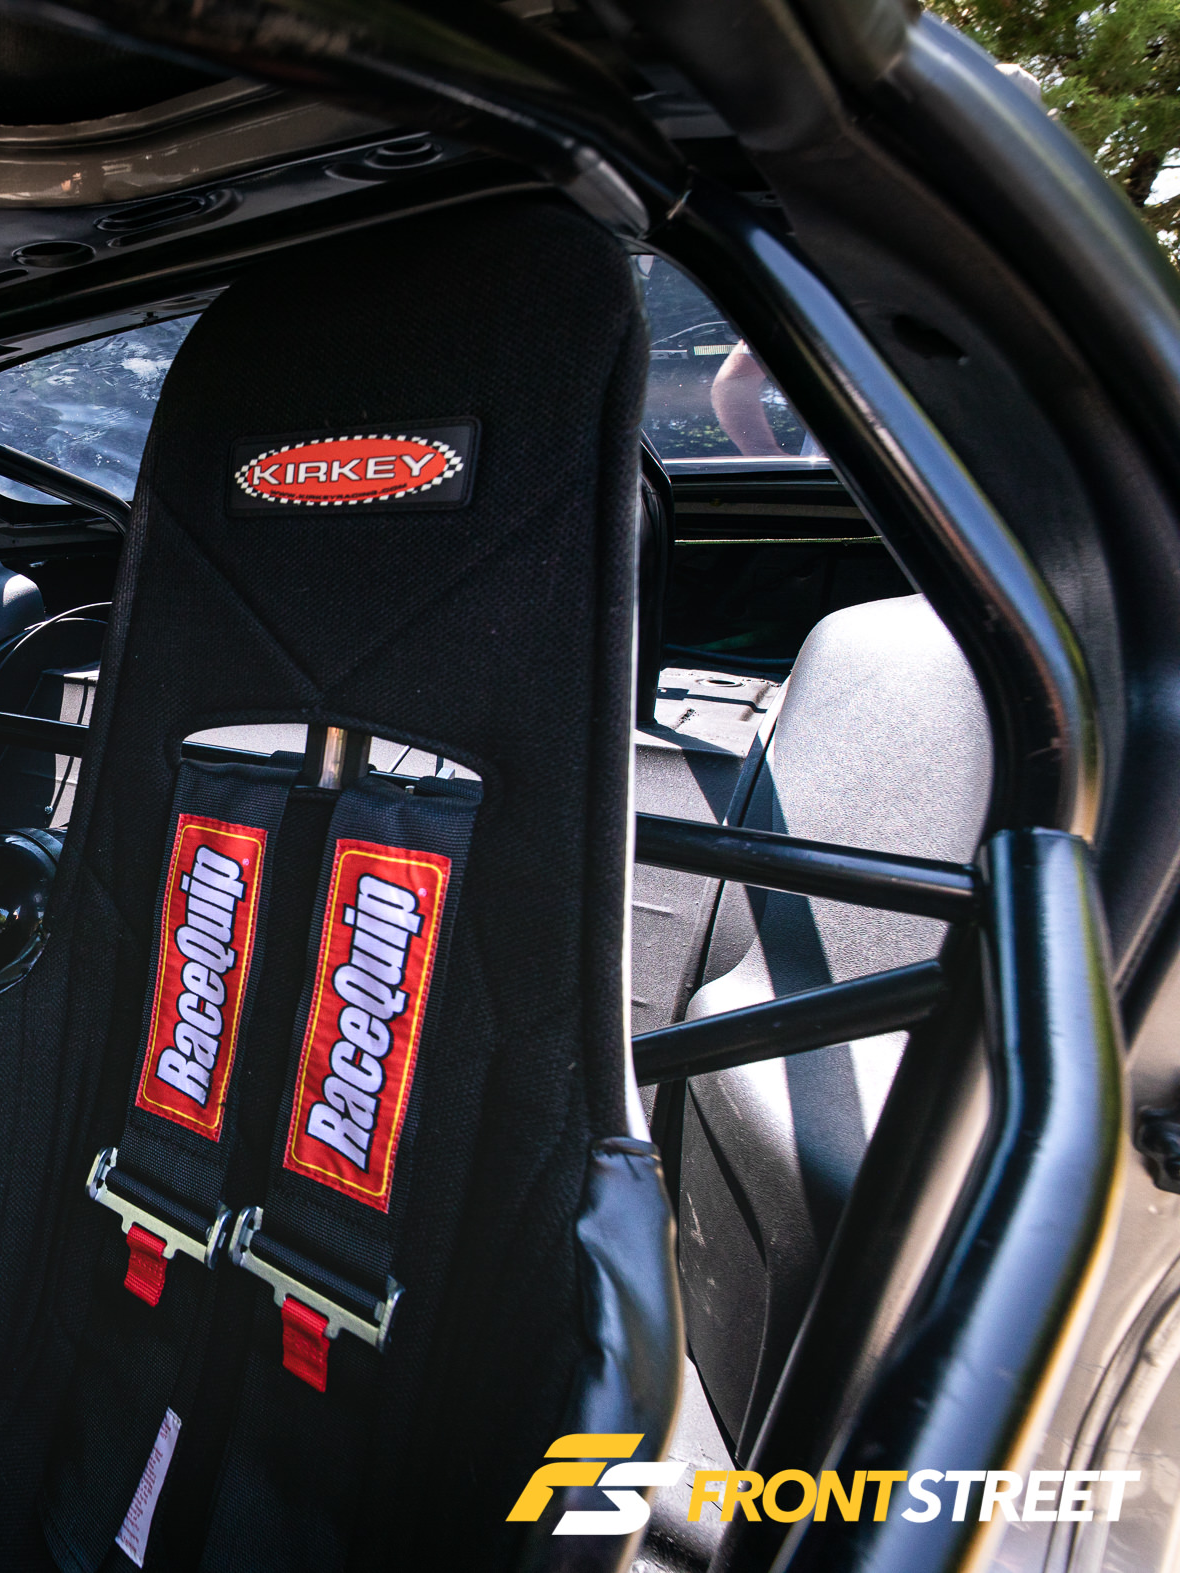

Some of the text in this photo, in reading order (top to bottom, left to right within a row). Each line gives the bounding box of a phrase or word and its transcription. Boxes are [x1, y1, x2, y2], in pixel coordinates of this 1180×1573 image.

[251, 453, 437, 486] KIRKEY
[156, 844, 248, 1107] RaceQuip
[305, 872, 427, 1174] RaceQuip
